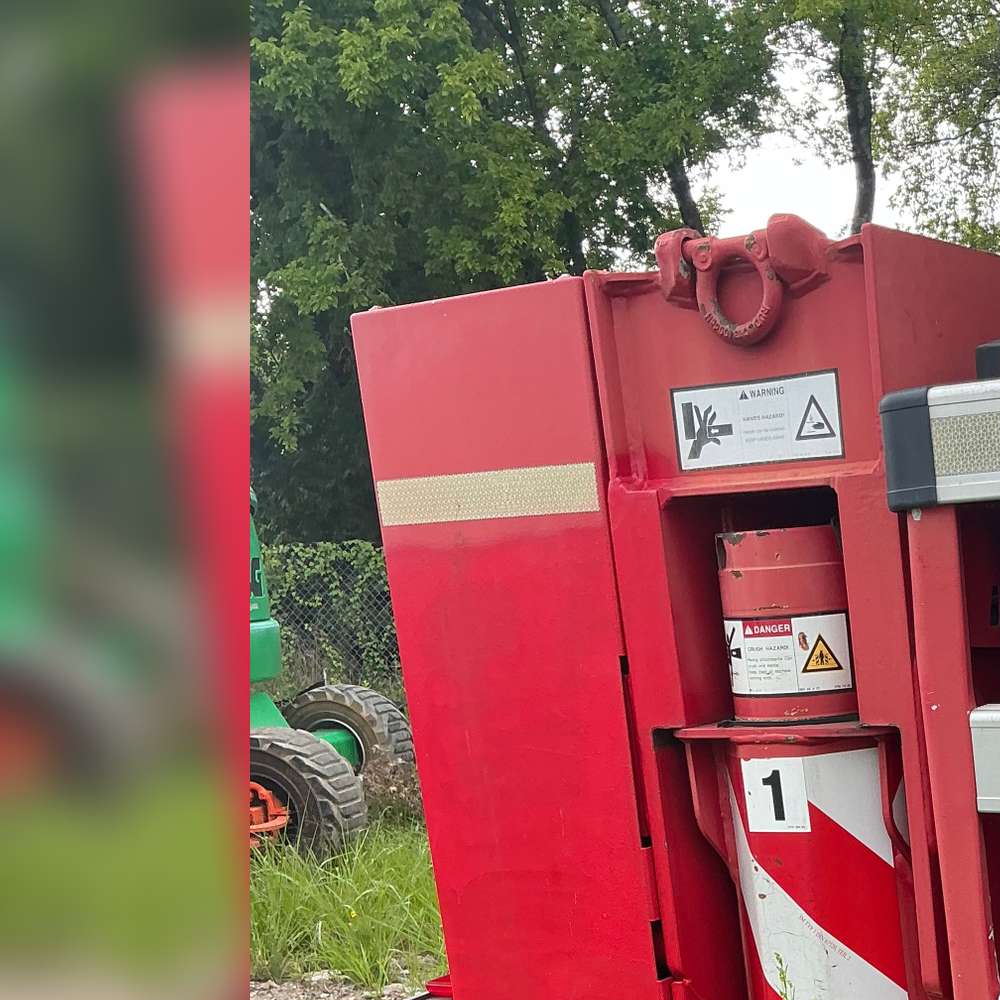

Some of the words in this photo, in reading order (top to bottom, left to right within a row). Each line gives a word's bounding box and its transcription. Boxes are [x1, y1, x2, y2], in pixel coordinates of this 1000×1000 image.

[750, 386, 785, 398] WARNING
[753, 624, 791, 634] DANGER
[761, 769, 786, 821] 1
